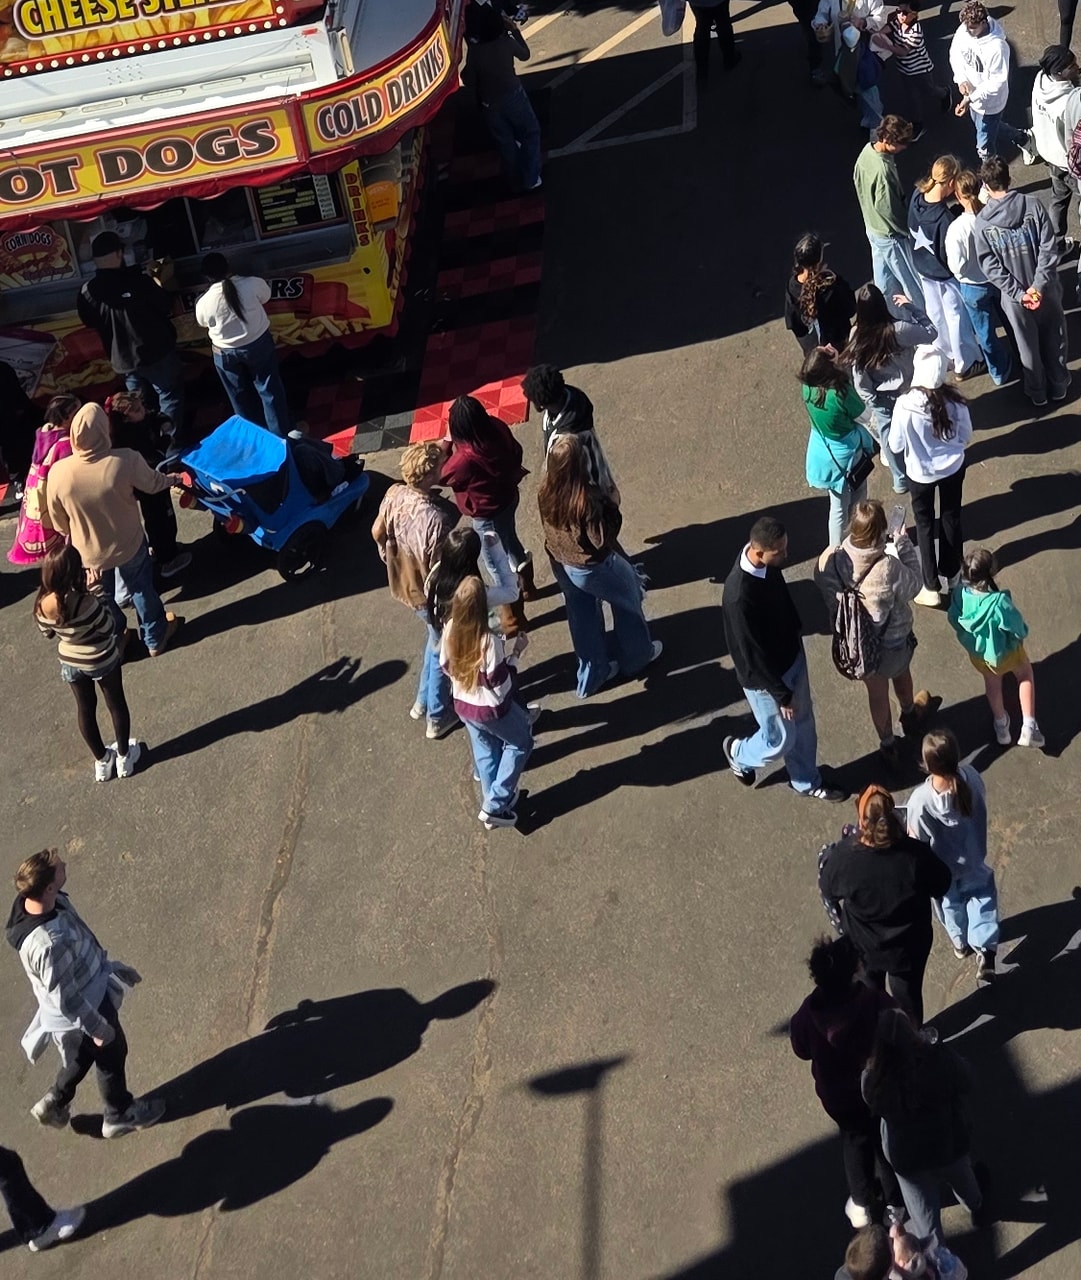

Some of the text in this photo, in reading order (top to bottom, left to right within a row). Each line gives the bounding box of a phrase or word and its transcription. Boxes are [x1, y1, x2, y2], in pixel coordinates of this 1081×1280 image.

[317, 36, 446, 141] COLD DRINKS
[97, 119, 279, 186] DOGS
[5, 231, 52, 252] CORN DOGS
[344, 172, 371, 247] DRINKS
